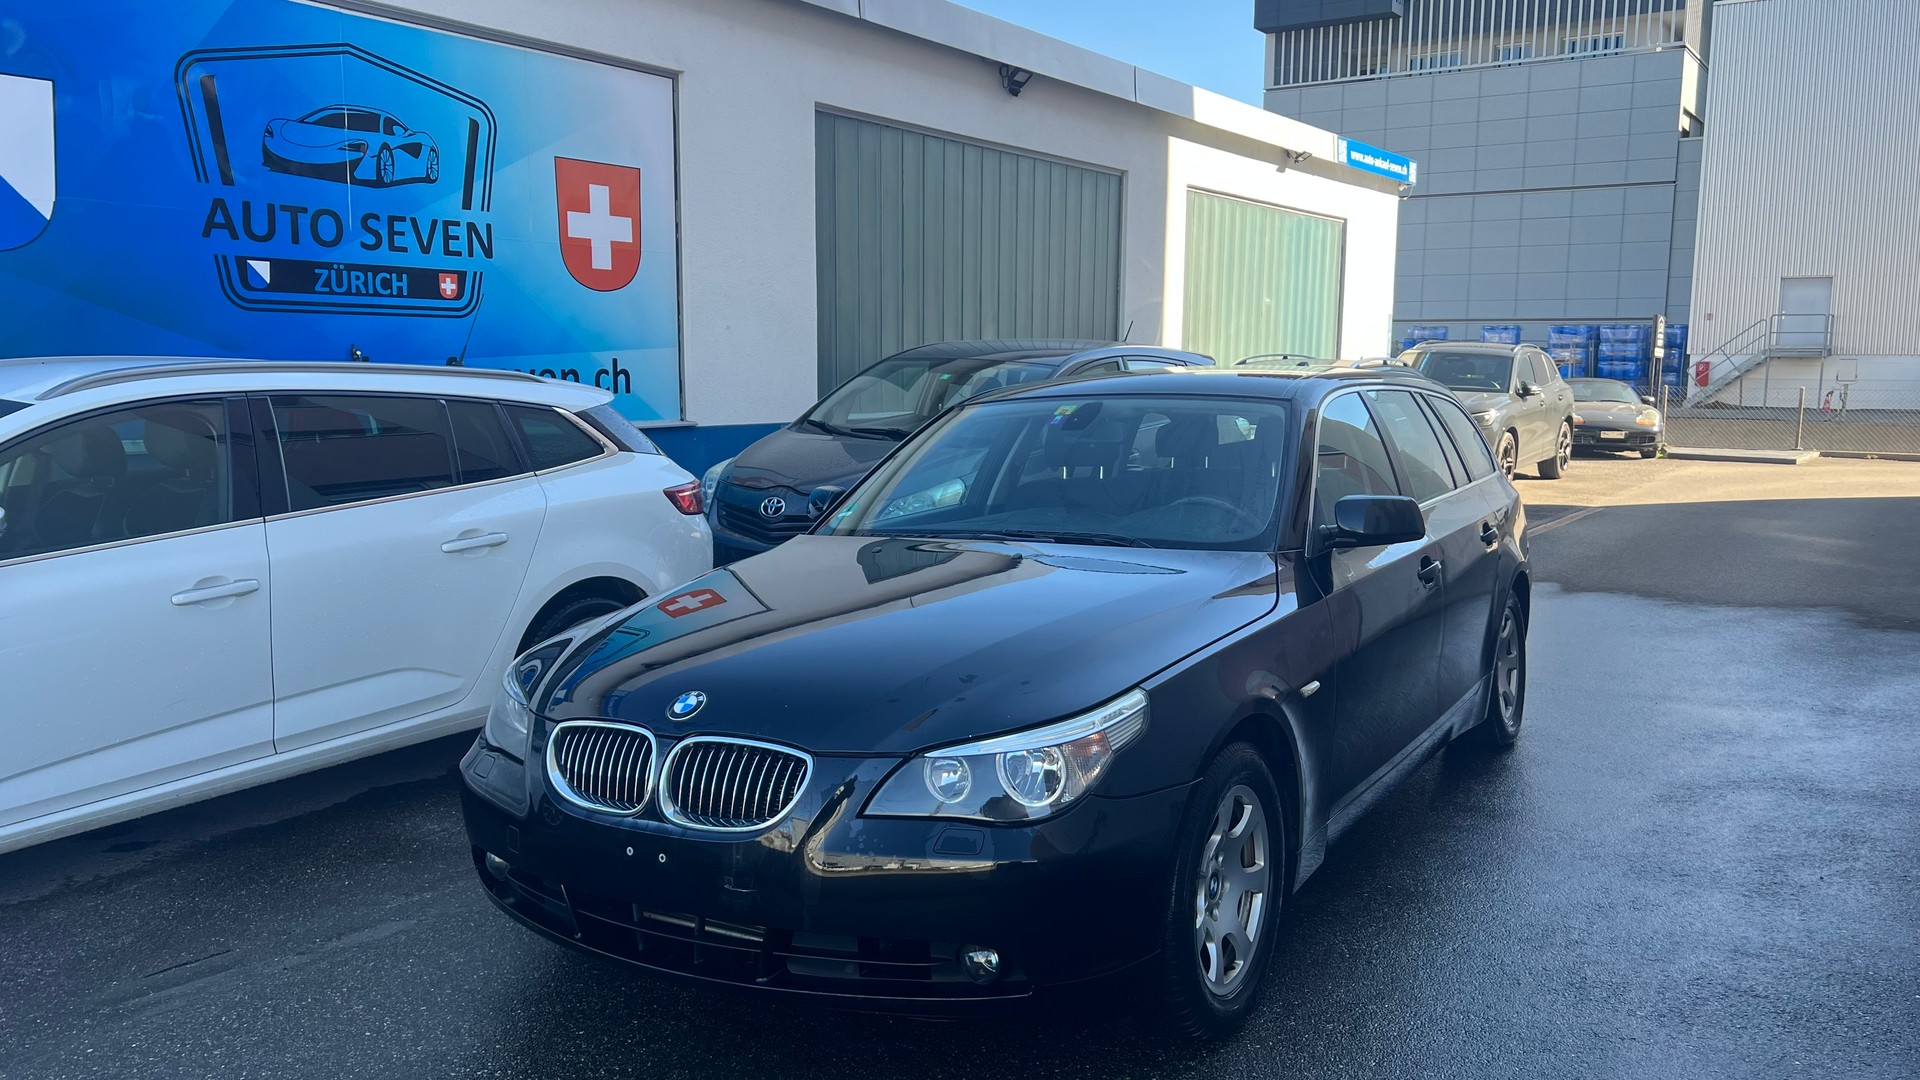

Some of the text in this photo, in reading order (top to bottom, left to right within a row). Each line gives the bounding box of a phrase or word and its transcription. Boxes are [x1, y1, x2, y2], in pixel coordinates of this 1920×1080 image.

[201, 197, 493, 259] AUTO SEVEN
[314, 264, 408, 296] ZÜRICH
